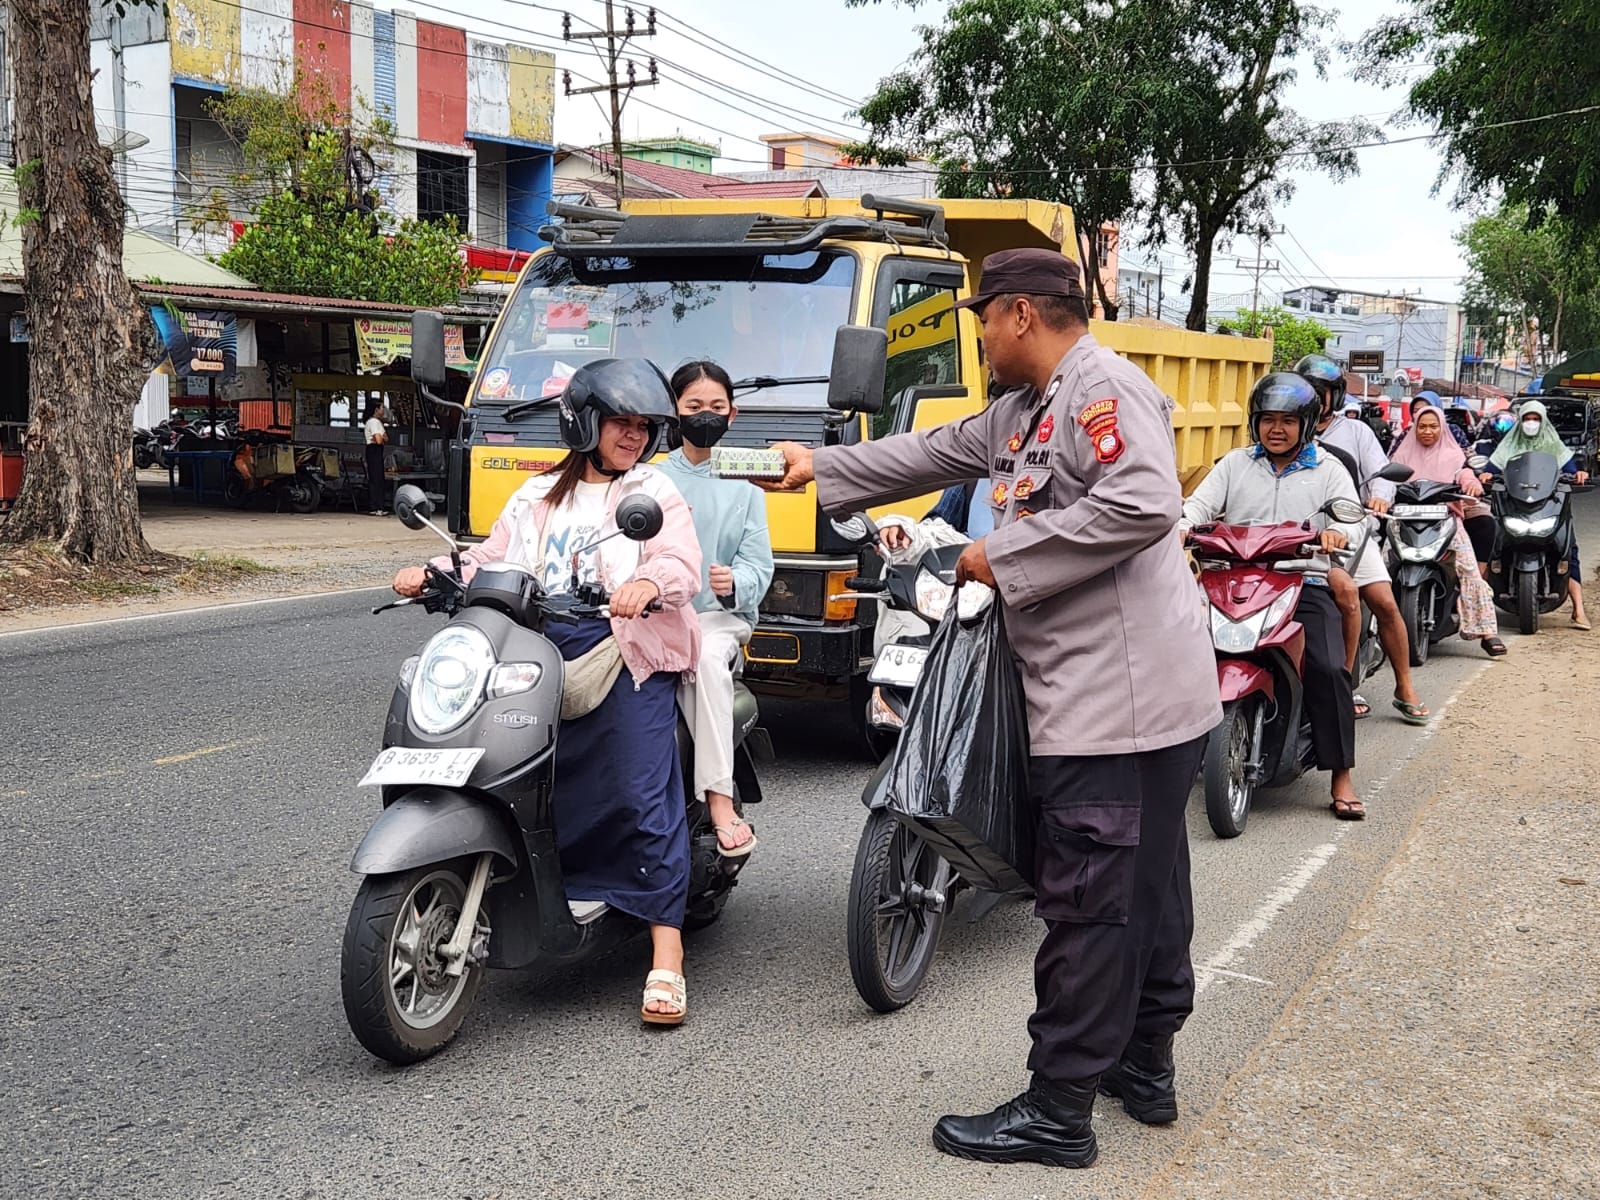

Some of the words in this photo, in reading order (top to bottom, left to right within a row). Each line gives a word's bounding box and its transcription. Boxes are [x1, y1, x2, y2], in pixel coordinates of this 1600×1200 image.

[194, 328, 221, 338] TERJAGA
[481, 457, 517, 470] COLT
[1024, 449, 1050, 466] POLRI
[882, 648, 905, 662] KB
[493, 714, 538, 726] STYLISH
[397, 751, 442, 765] 3635
